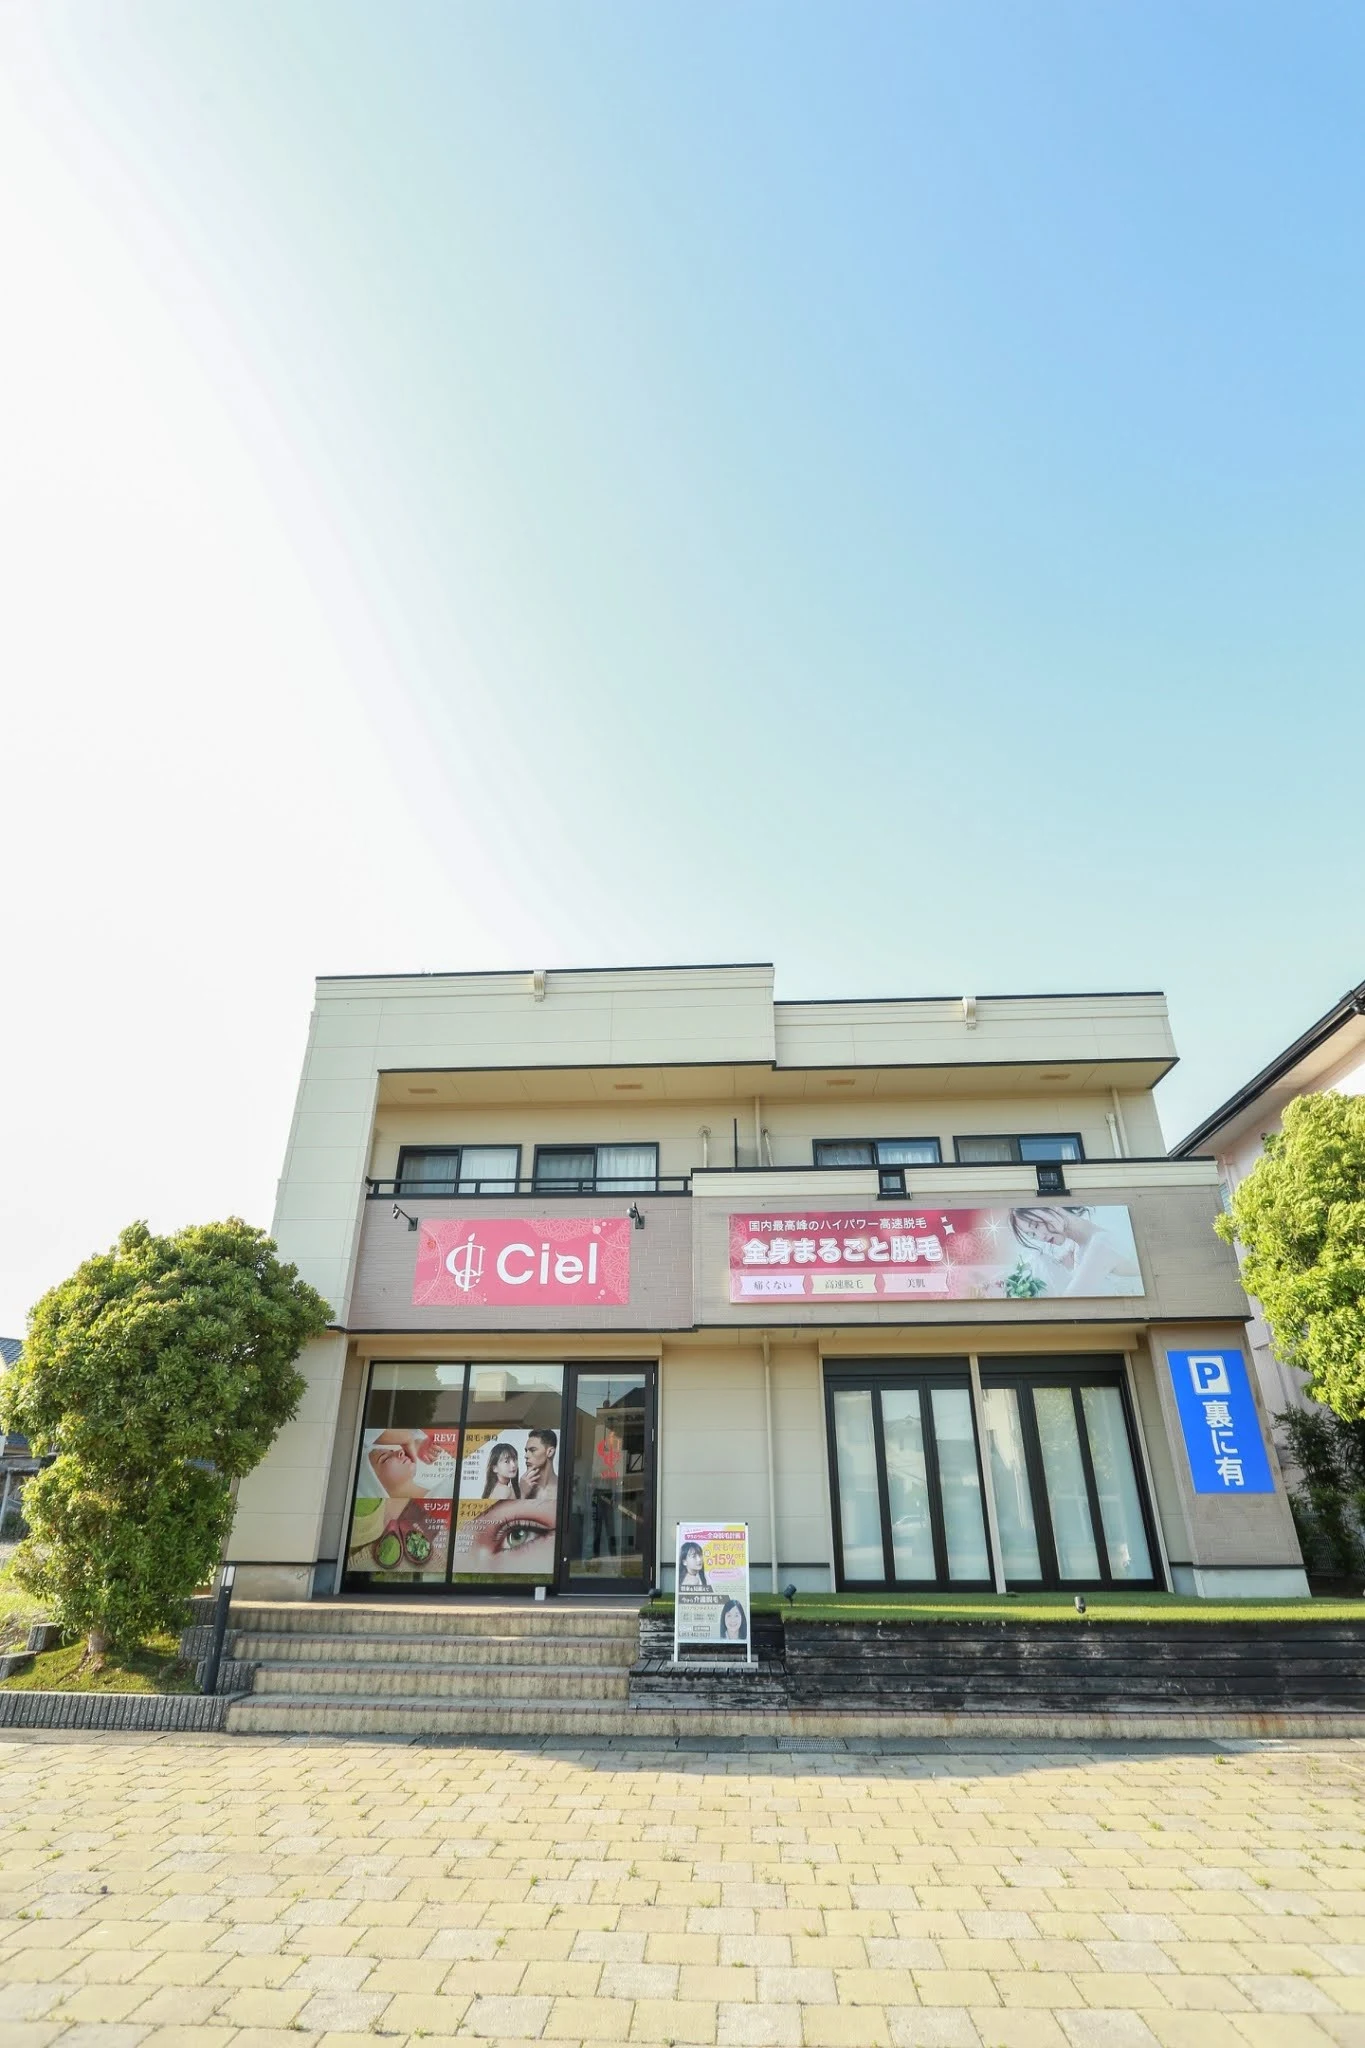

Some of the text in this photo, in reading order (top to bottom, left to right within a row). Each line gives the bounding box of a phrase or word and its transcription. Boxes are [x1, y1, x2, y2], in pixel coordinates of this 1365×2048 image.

[748, 1216, 928, 1232] 国内最高峰のハイパワー高速脱毛
[742, 1234, 944, 1265] 全身まるごと脱毛
[496, 1242, 598, 1285] Ciel
[753, 1281, 793, 1291] 痛くない
[824, 1279, 864, 1291] 高速脱毛
[907, 1278, 926, 1290] 美肌
[1195, 1362, 1221, 1389] P
[433, 1433, 457, 1443] REVI
[1202, 1400, 1245, 1487] 裏に有
[423, 1502, 451, 1511] モリンガ
[713, 1553, 736, 1566] 15%
